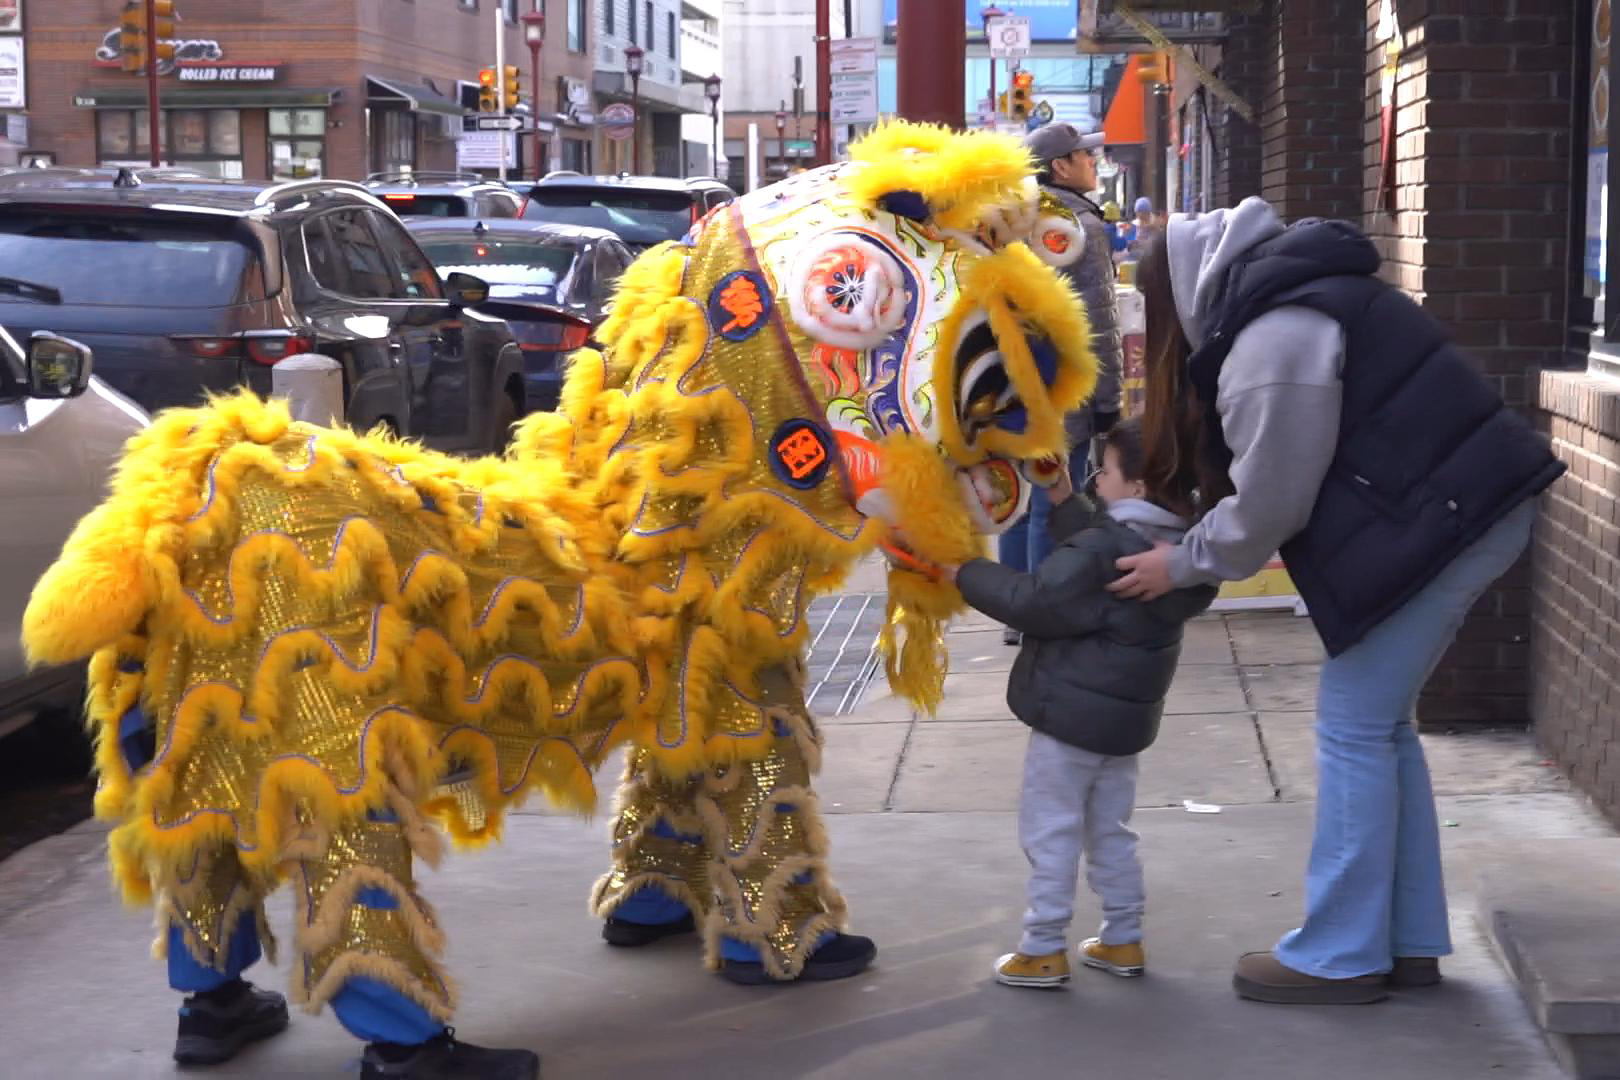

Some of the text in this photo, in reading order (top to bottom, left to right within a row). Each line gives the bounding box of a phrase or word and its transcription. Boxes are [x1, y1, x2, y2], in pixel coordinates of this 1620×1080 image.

[179, 67, 275, 80] ROLLED ICE CREAM
